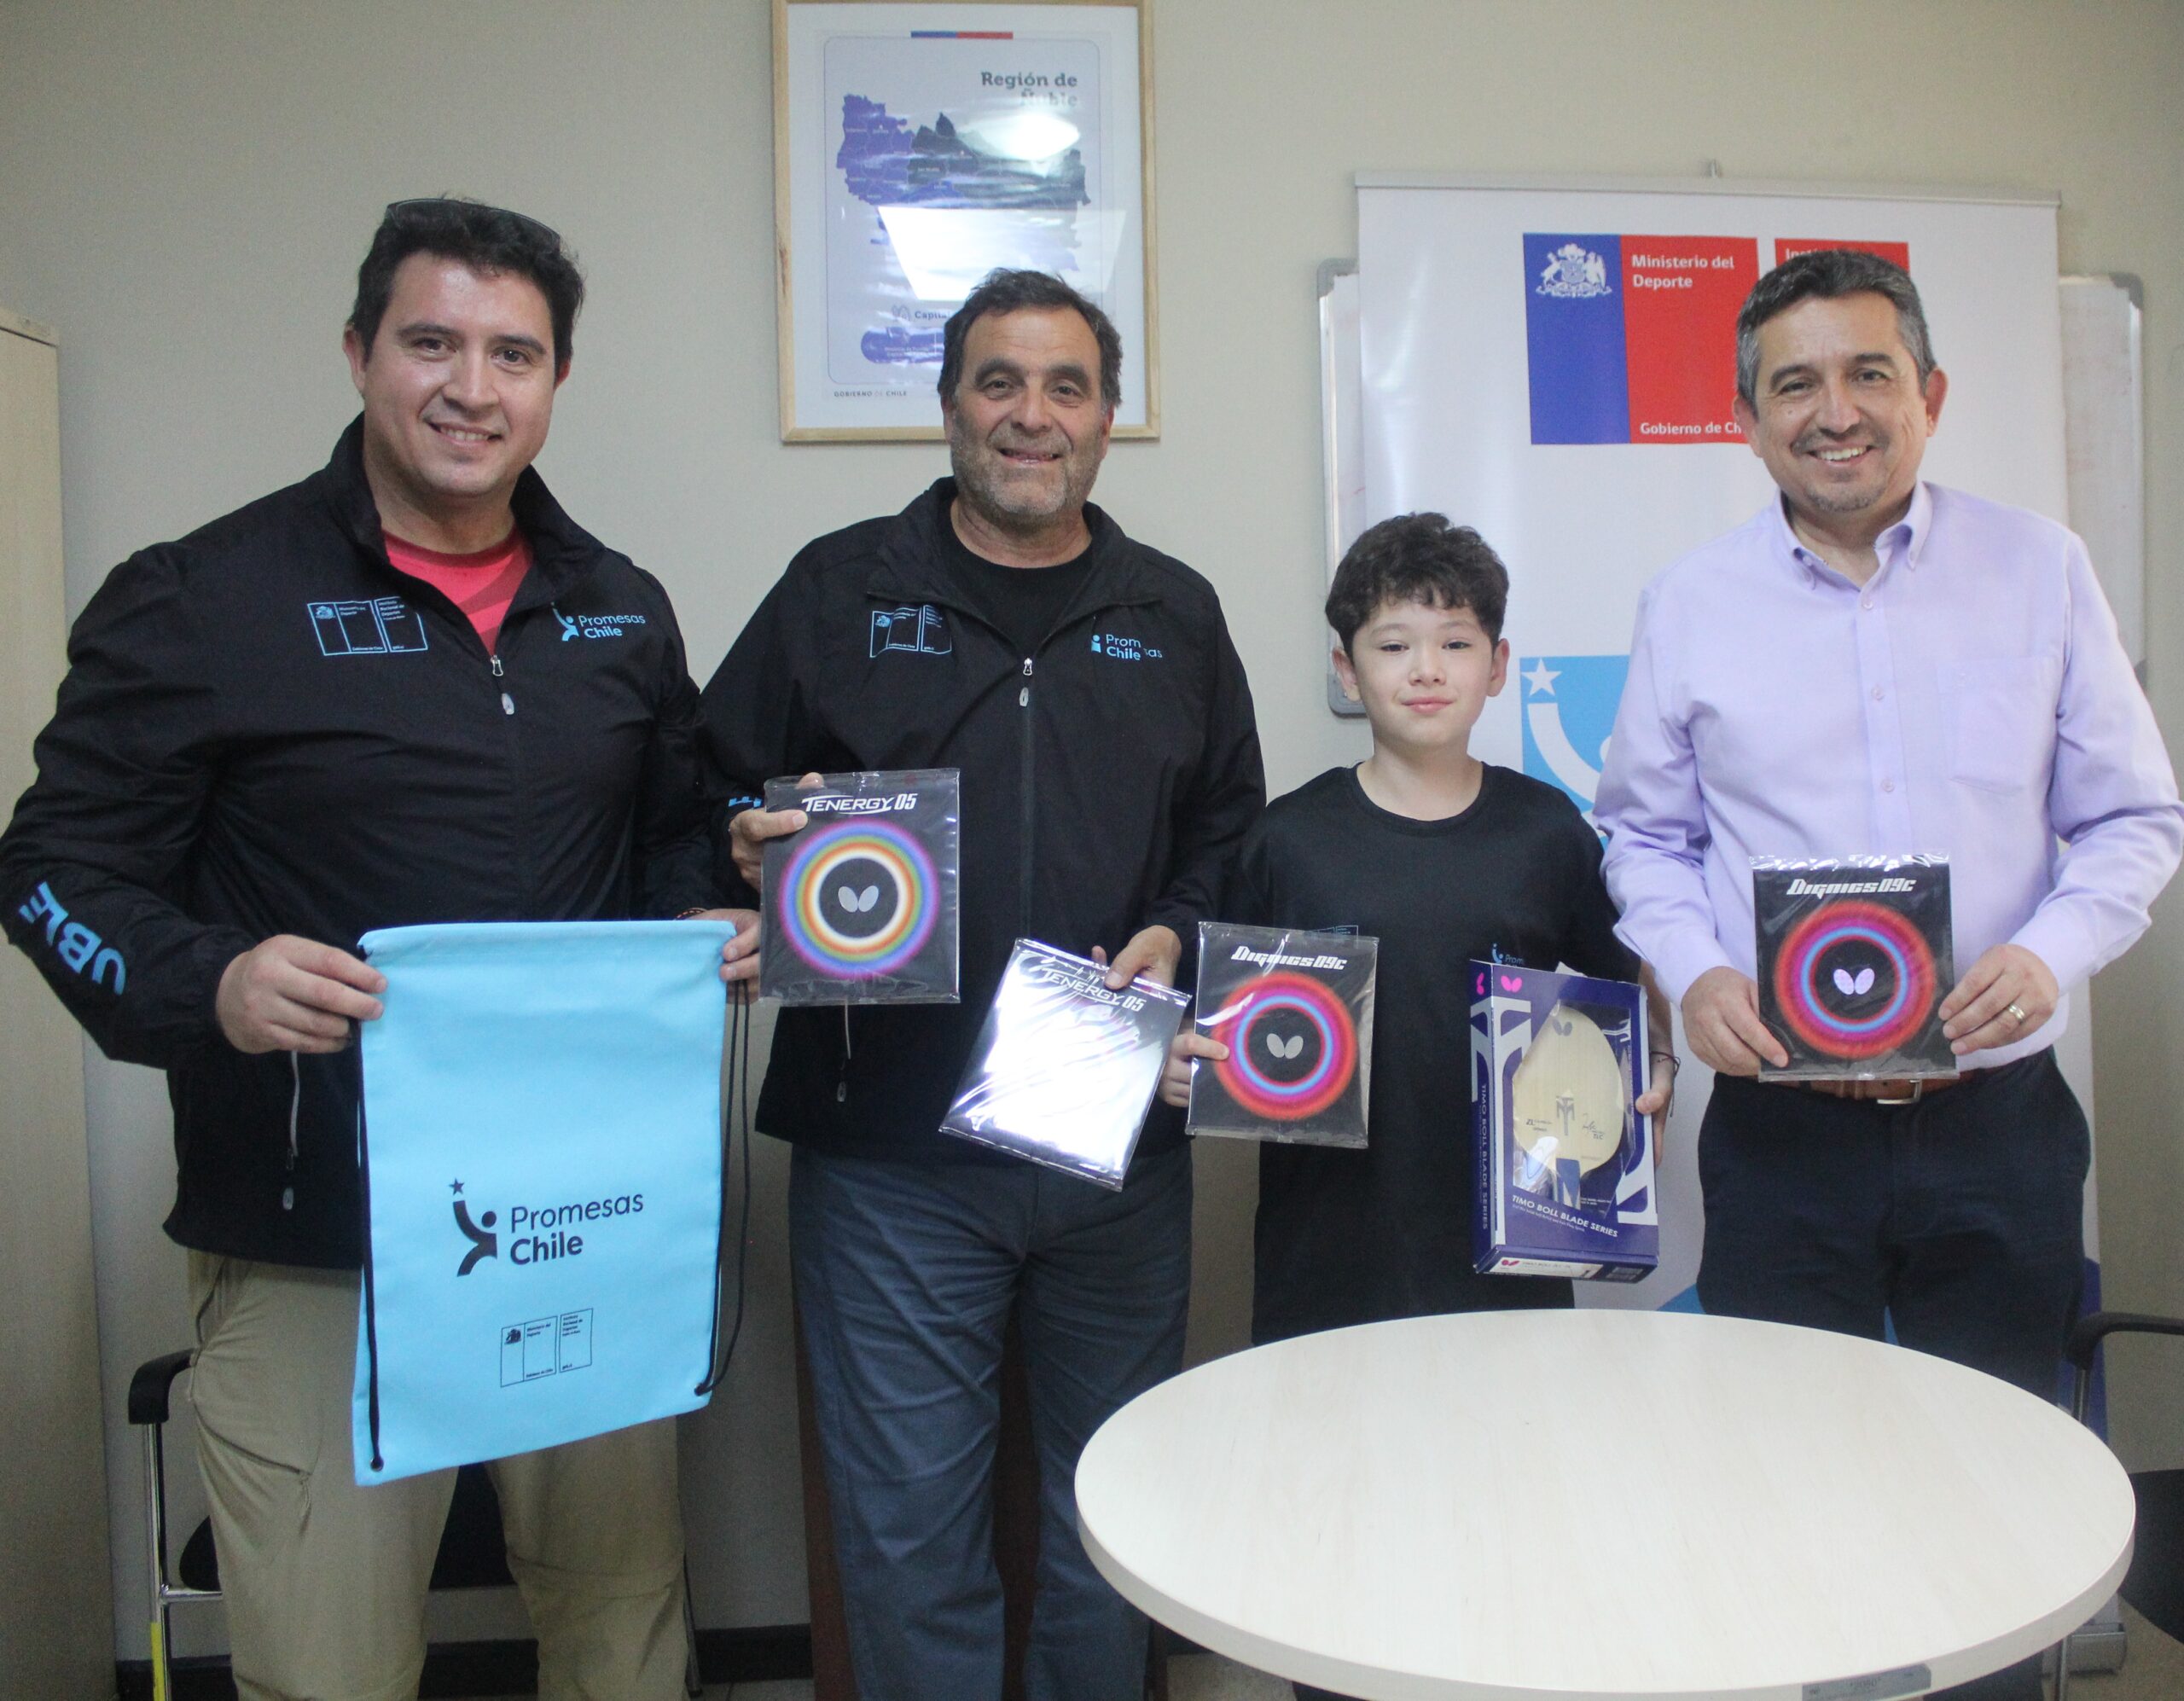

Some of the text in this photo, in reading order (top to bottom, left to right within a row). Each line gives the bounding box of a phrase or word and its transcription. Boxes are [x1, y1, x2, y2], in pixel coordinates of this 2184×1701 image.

[981, 72, 1077, 90] Región de
[1631, 254, 1734, 270] Ministerio del
[1633, 274, 1693, 291] Deporte
[1640, 422, 1702, 434] Gobierno
[1705, 421, 1722, 434] de
[578, 614, 646, 627] Promesas
[584, 626, 623, 639] Chile
[1107, 646, 1141, 661] Chile
[511, 1193, 644, 1234] Promesas
[1512, 1194, 1535, 1209] TIMO
[1536, 1204, 1559, 1218] BOLL
[1560, 1212, 1589, 1228] BLADE
[1590, 1222, 1618, 1238] SERIES
[509, 1231, 584, 1266] Chile
